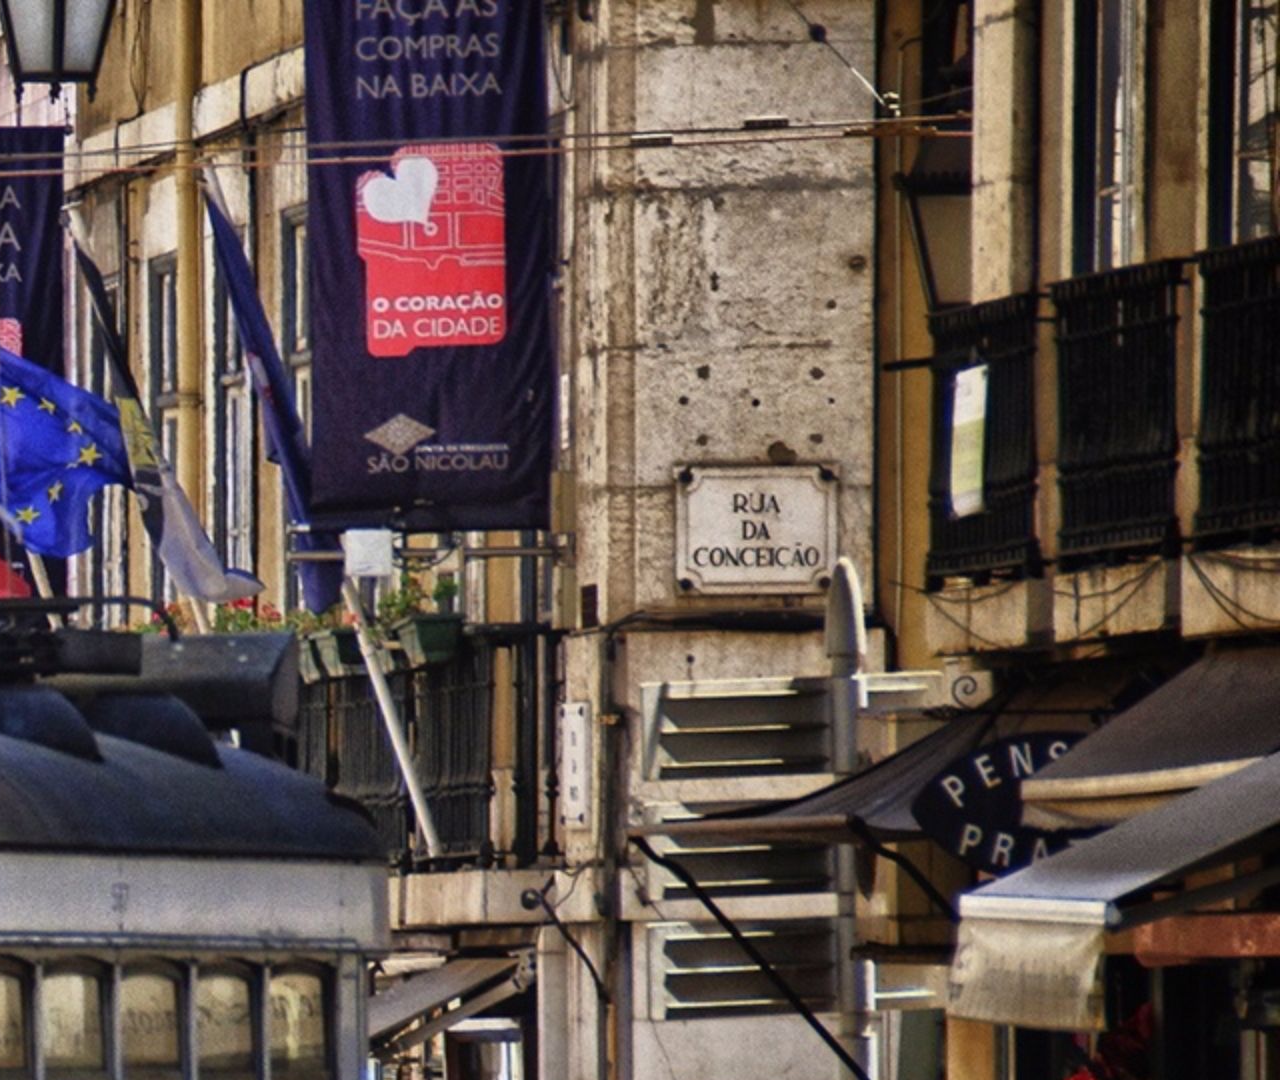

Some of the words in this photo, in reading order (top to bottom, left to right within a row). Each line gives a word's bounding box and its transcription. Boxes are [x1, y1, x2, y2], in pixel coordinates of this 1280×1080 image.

[355, 0, 449, 26] FAÇA
[455, 0, 500, 18] AS
[356, 33, 501, 61] COMPRAS
[356, 75, 403, 99] NA
[410, 72, 503, 98] BAIXA
[373, 297, 389, 313] O
[394, 291, 503, 315] CORAÇÃO
[374, 319, 407, 339] DA
[413, 316, 502, 337] CIDADE
[367, 453, 410, 474] SÃO
[415, 453, 509, 471] NICOLAU
[733, 492, 781, 514] RUA
[742, 520, 771, 541] DA
[693, 542, 820, 570] CONCEIÇÃO
